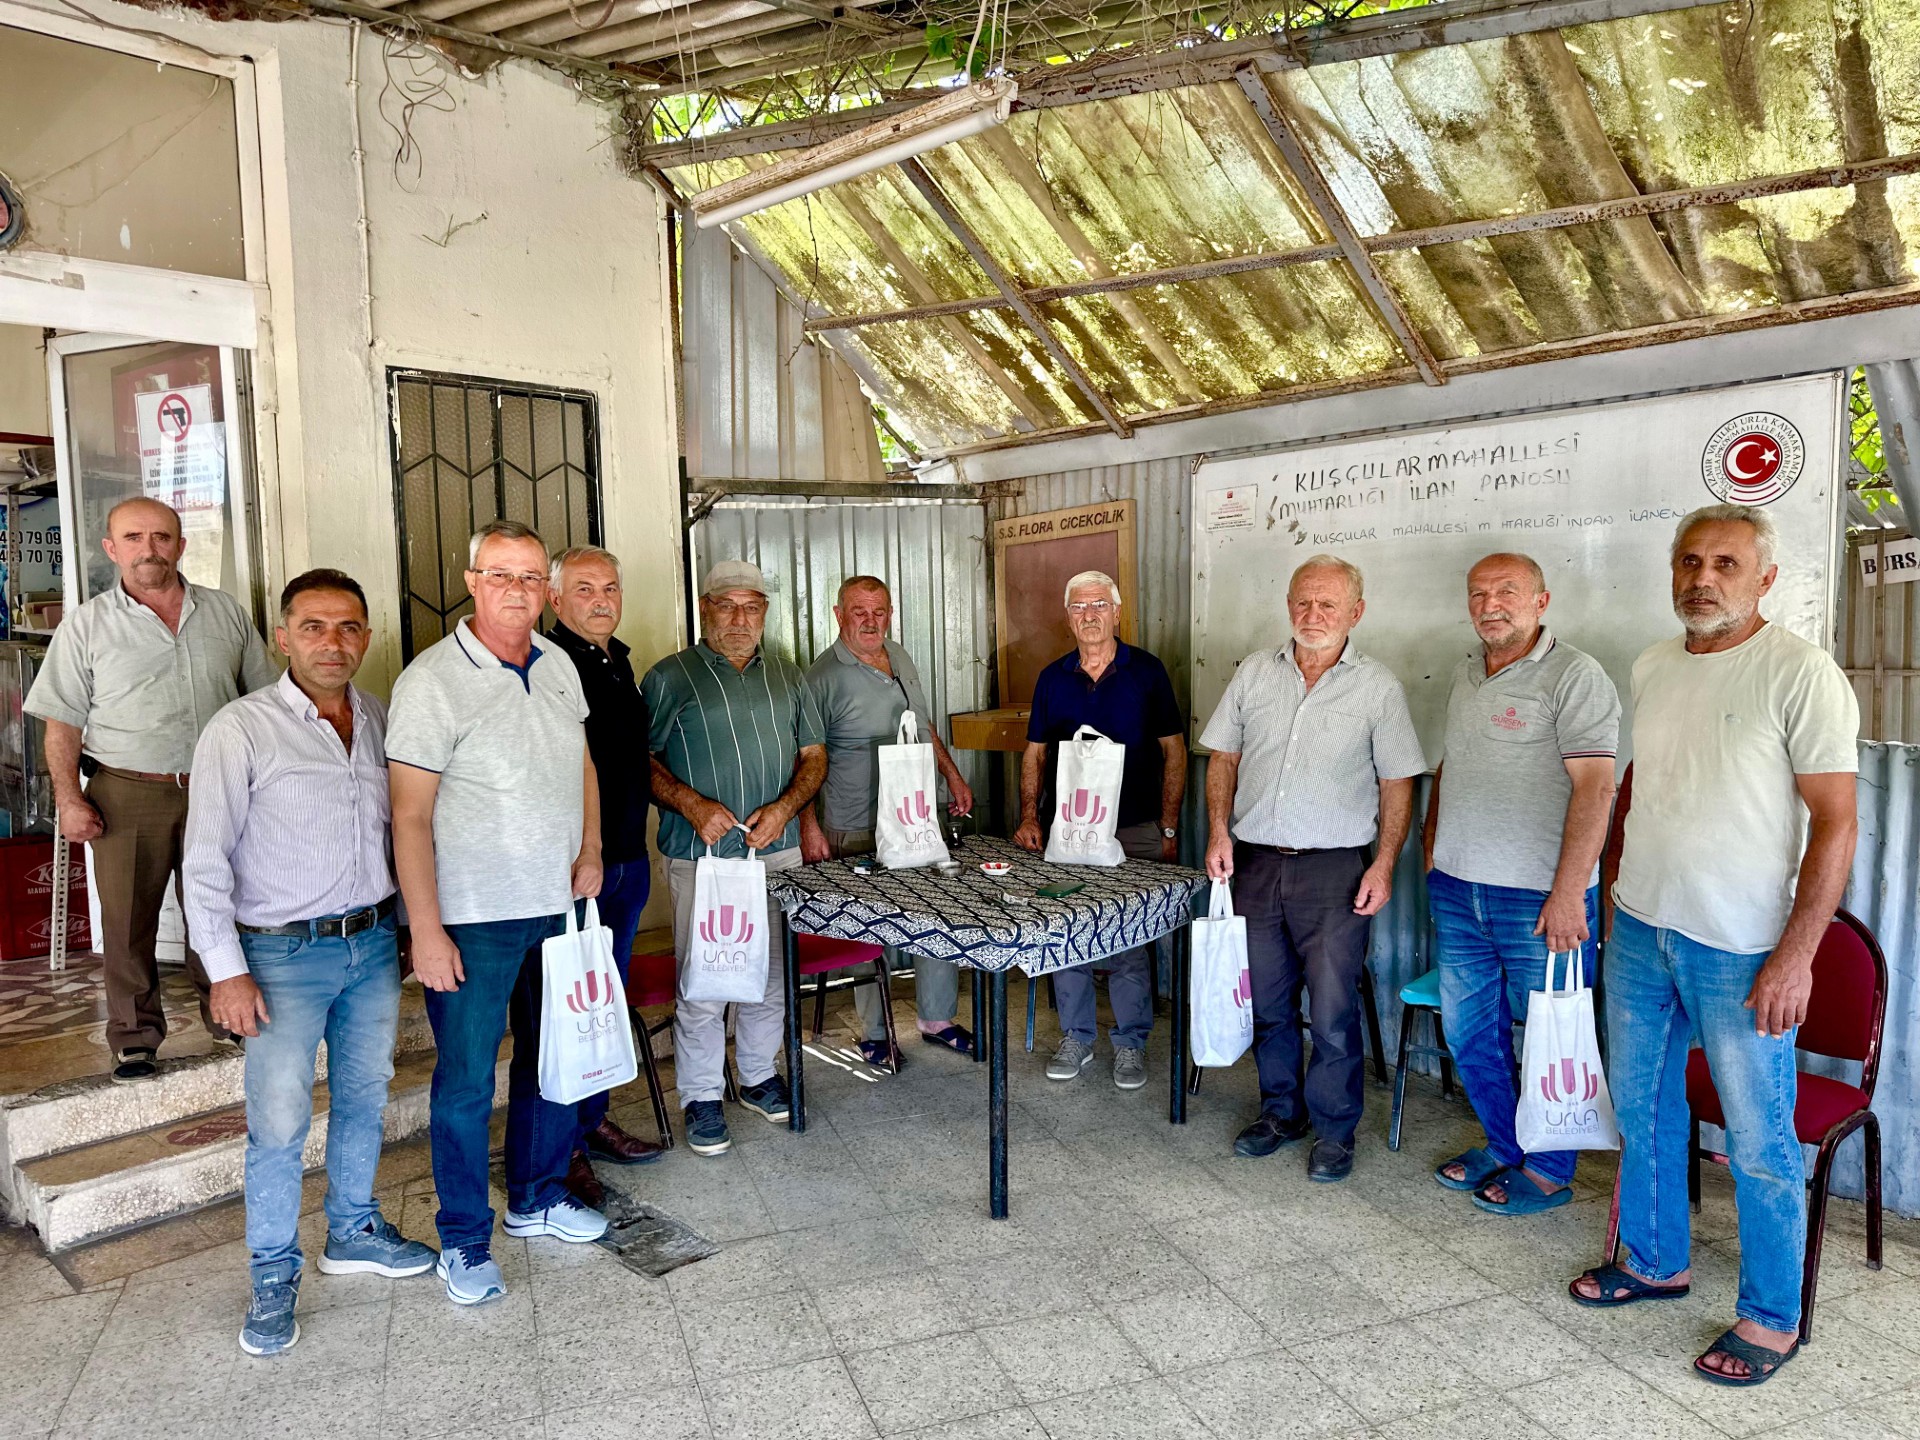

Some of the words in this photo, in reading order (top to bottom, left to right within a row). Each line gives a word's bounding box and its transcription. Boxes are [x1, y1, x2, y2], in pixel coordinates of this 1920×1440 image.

[1740, 415, 1768, 425] URLA
[1296, 456, 1422, 493] KUŞÇULAR
[1410, 480, 1455, 500] İLAN
[1480, 468, 1571, 491] PANOSU
[999, 526, 1016, 539] S.S.
[1019, 520, 1053, 537] FLORA
[26, 531, 42, 544] 79
[45, 531, 61, 545] 09
[26, 550, 42, 563] 70
[46, 550, 62, 563] 76
